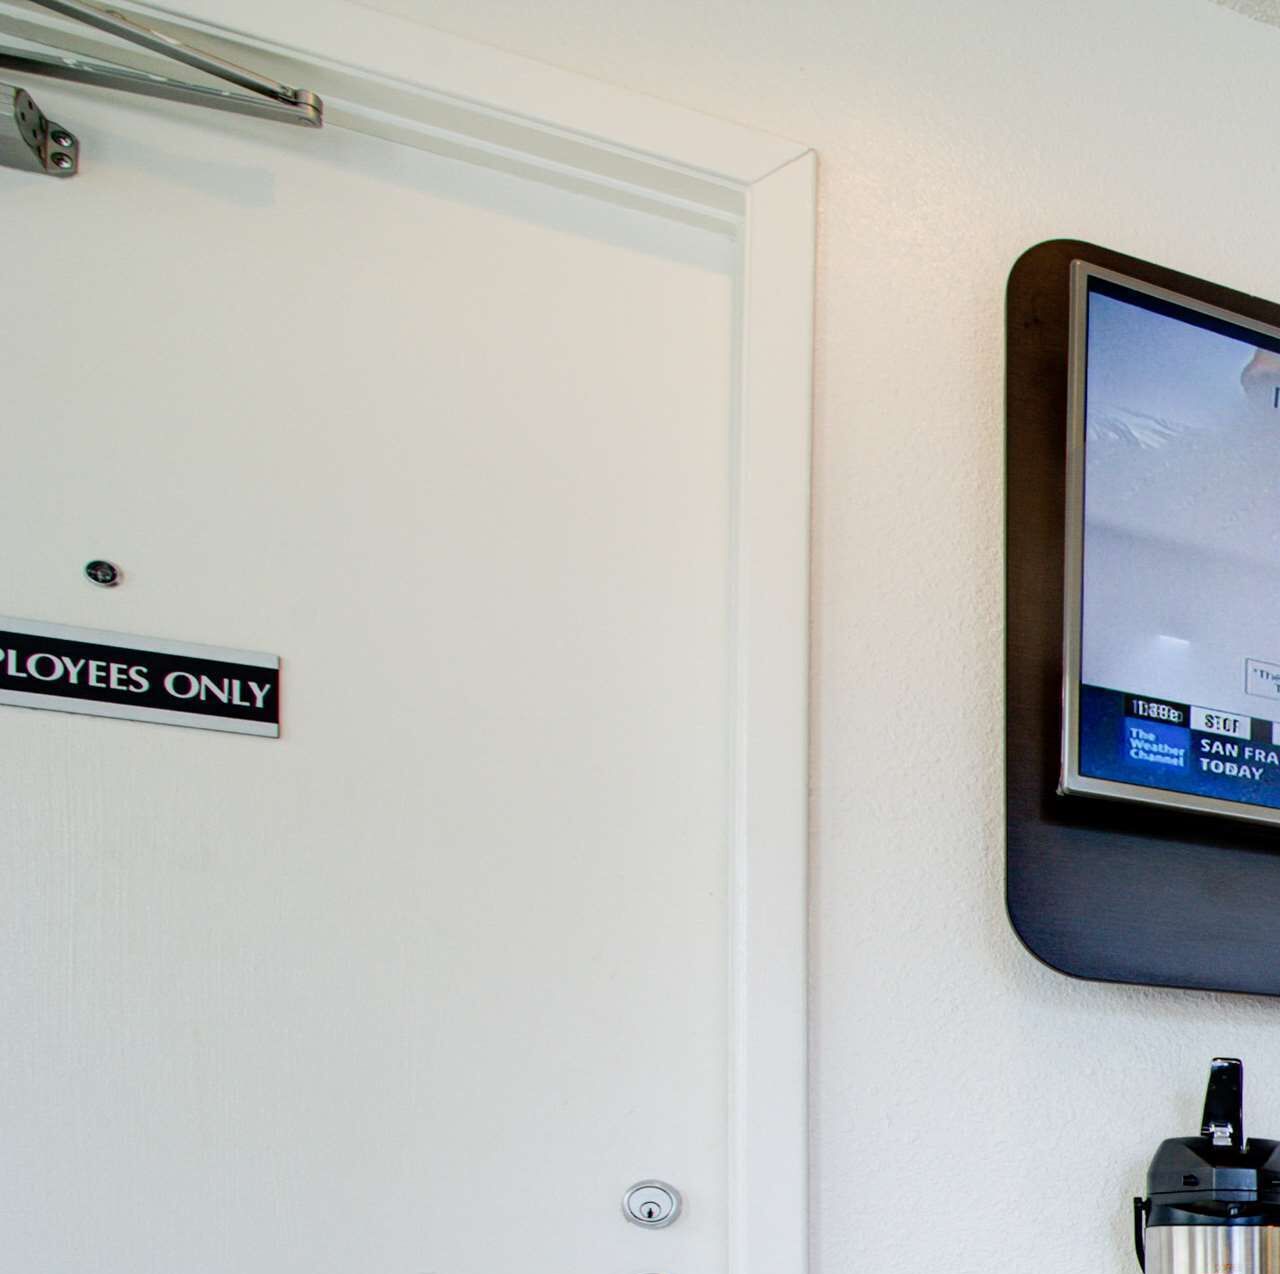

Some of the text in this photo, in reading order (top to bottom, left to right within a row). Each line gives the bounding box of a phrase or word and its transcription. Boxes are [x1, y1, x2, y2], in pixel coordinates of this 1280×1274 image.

[0, 648, 271, 709] LOYEES ONLY
[1200, 738, 1239, 758] SAN
[1200, 757, 1264, 781] TODAY
